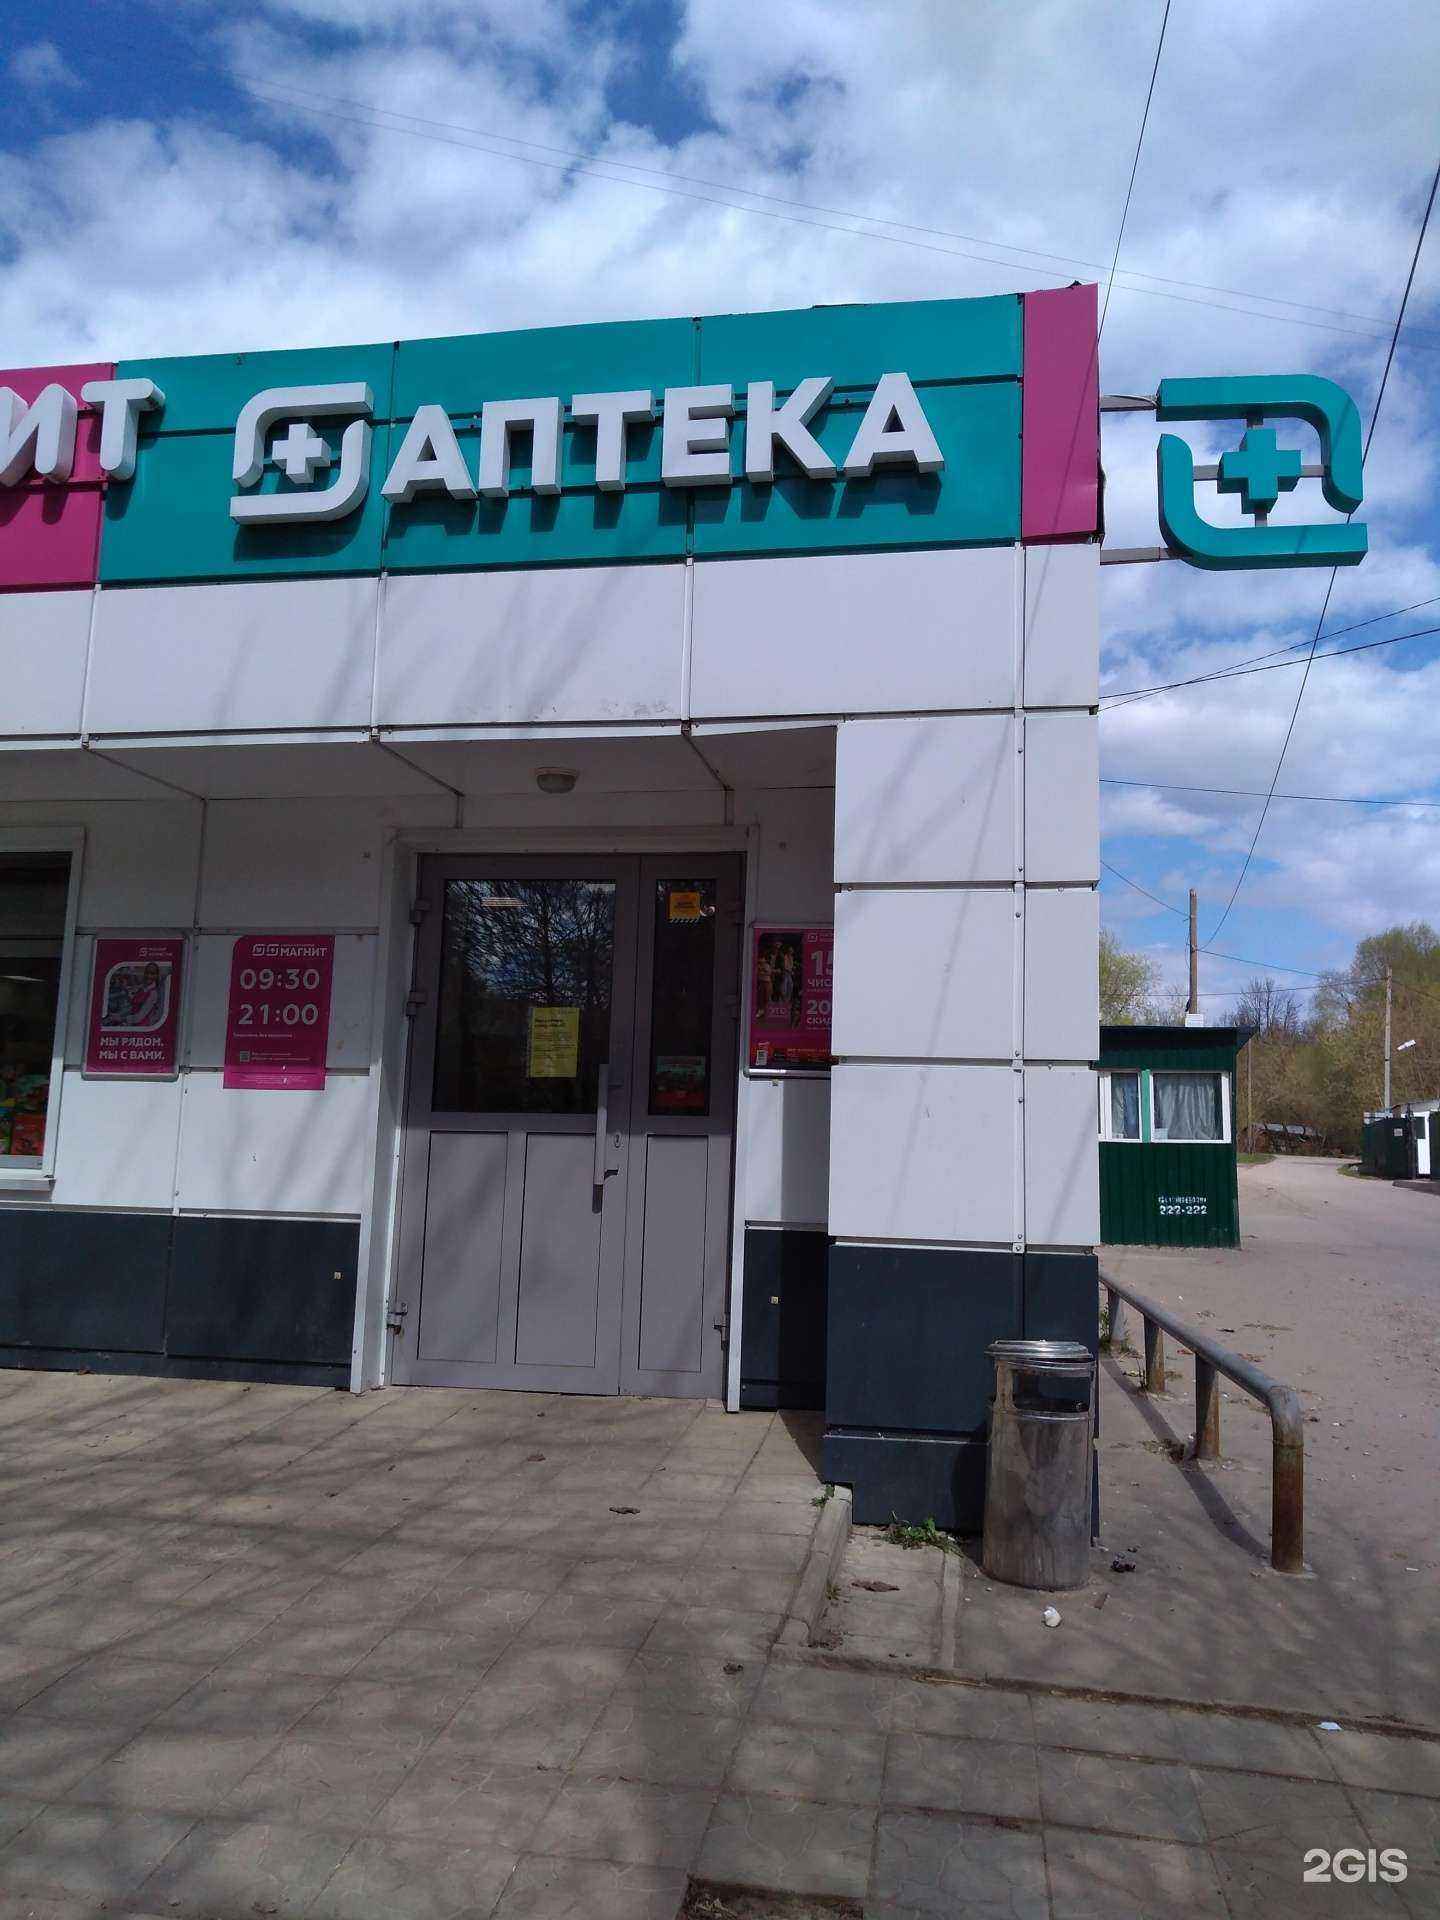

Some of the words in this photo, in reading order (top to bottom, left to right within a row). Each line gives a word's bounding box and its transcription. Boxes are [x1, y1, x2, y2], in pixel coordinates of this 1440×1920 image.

[380, 372, 945, 503] АПТЕКА
[280, 947, 328, 957] МАГНИТ
[239, 968, 321, 990] 09:30
[238, 1003, 319, 1025] 21:00
[100, 1037, 119, 1046] МЫ
[121, 1037, 164, 1048] РЯДОМ.
[99, 1050, 118, 1060] МЫ
[120, 1050, 128, 1060] С
[129, 1050, 165, 1060] ВАМИ.
